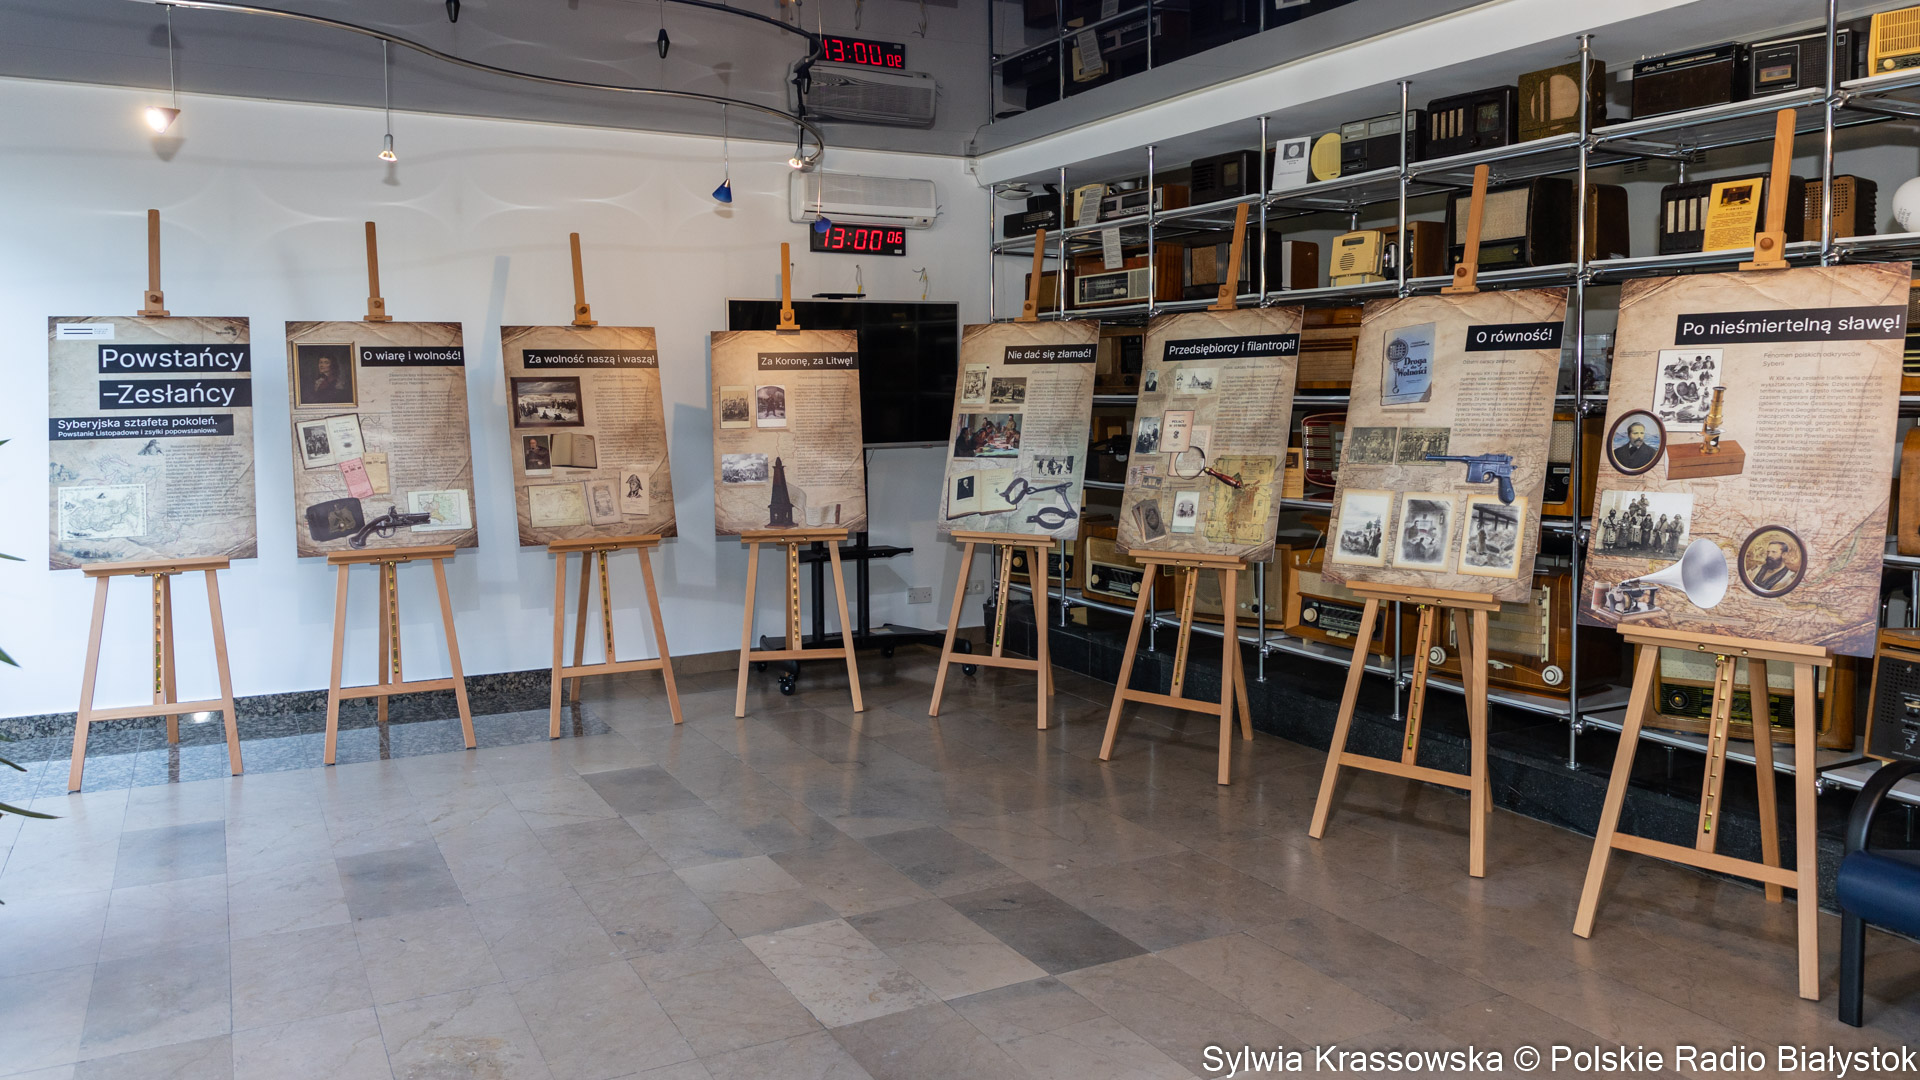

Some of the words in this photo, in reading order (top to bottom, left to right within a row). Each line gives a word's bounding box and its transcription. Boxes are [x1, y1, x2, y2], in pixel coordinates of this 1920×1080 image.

[824, 227, 883, 251] 13:00
[887, 231, 903, 244] 06
[1683, 322, 1705, 336] Po
[1710, 316, 1831, 335] nieśmiertelną
[1838, 314, 1900, 333] sławę!
[1476, 331, 1487, 343] O
[1490, 329, 1553, 343] równość!
[1169, 343, 1239, 355] Przedsiębiorcy
[1241, 341, 1245, 351] i
[1247, 339, 1295, 353] filantropi!
[102, 347, 244, 371] Powstańcy
[363, 351, 372, 360] O
[375, 351, 405, 362] wiarę
[414, 350, 461, 360] wolność!
[528, 355, 541, 364] Za
[544, 354, 584, 363] wolność
[587, 356, 615, 365] naszą
[622, 355, 655, 365] waszą!
[761, 357, 773, 365] Za
[776, 357, 810, 366] Koronę,
[826, 356, 853, 366] Litwę!
[1007, 350, 1022, 359] Nie
[1024, 350, 1040, 359] dać
[1042, 350, 1055, 360] się
[1057, 349, 1092, 359] złamać!
[1404, 357, 1427, 367] Droga
[58, 418, 121, 430] Syberyjska
[124, 417, 168, 428] sztafeta
[172, 416, 218, 429] pokoleń.
[95, 430, 139, 438] Listopadowe
[144, 428, 164, 436] zsyłki
[165, 428, 218, 436] popowstaniowe.
